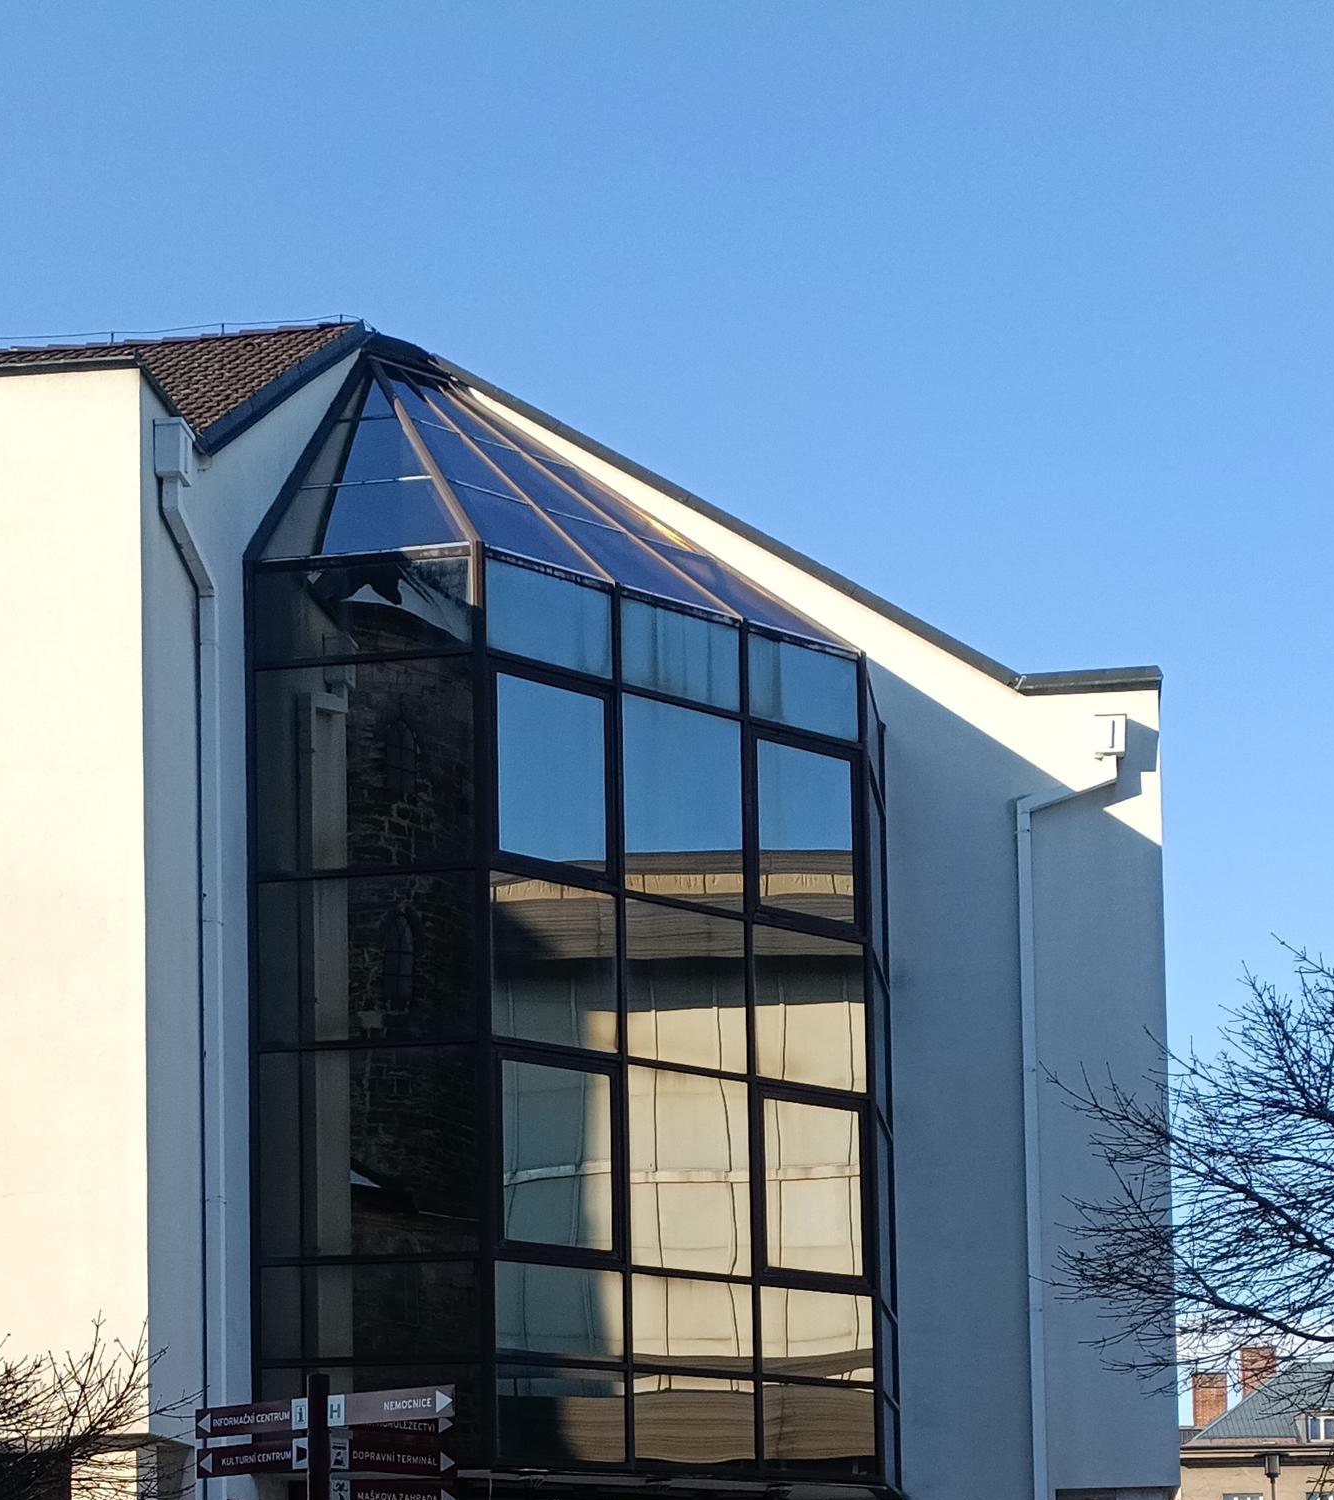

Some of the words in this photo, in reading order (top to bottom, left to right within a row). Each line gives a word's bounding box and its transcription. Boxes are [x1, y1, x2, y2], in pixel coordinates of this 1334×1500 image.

[383, 1398, 432, 1411] NEMOCNICE
[212, 1411, 255, 1427] INFORMAČNÍ
[256, 1410, 290, 1423] CENTRUM
[221, 1452, 257, 1466] KULTURNÍ
[257, 1450, 292, 1463] CENTRUM
[352, 1450, 395, 1463] DOPRAVNÍ
[396, 1452, 438, 1466] TERMINÁL
